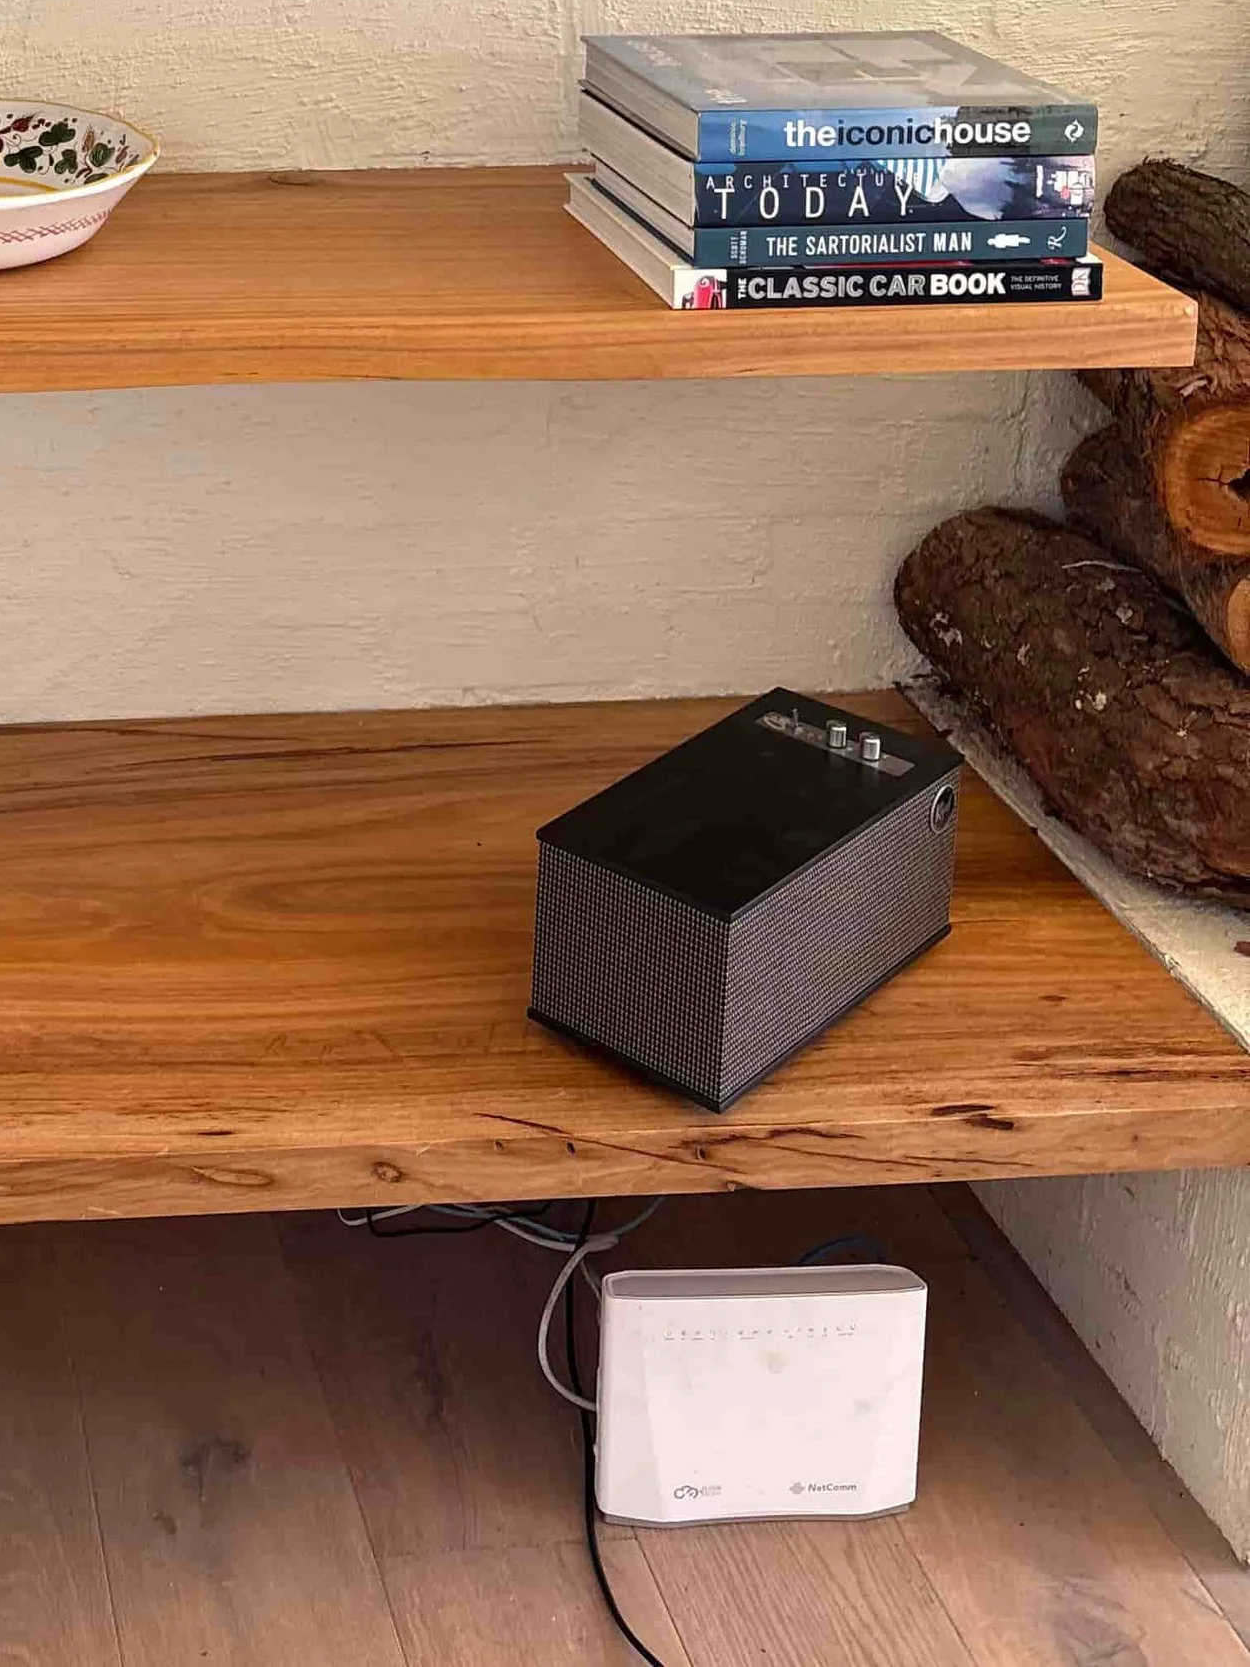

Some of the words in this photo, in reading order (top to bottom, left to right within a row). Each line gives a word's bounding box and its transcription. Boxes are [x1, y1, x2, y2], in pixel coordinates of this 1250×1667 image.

[714, 185, 913, 220] TODAY
[766, 236, 798, 256] THE
[806, 233, 927, 255] SARTORIALIST
[933, 232, 973, 252] MAN
[738, 278, 747, 300] THE
[748, 275, 864, 300] CLASSIC
[869, 274, 927, 298] CAR
[929, 271, 1006, 296] BOOK
[1024, 274, 1059, 282] DEFINITIVE
[1010, 283, 1032, 291] VISUAL
[1034, 283, 1063, 291] HISTORY
[807, 1483, 858, 1493] NetComm
